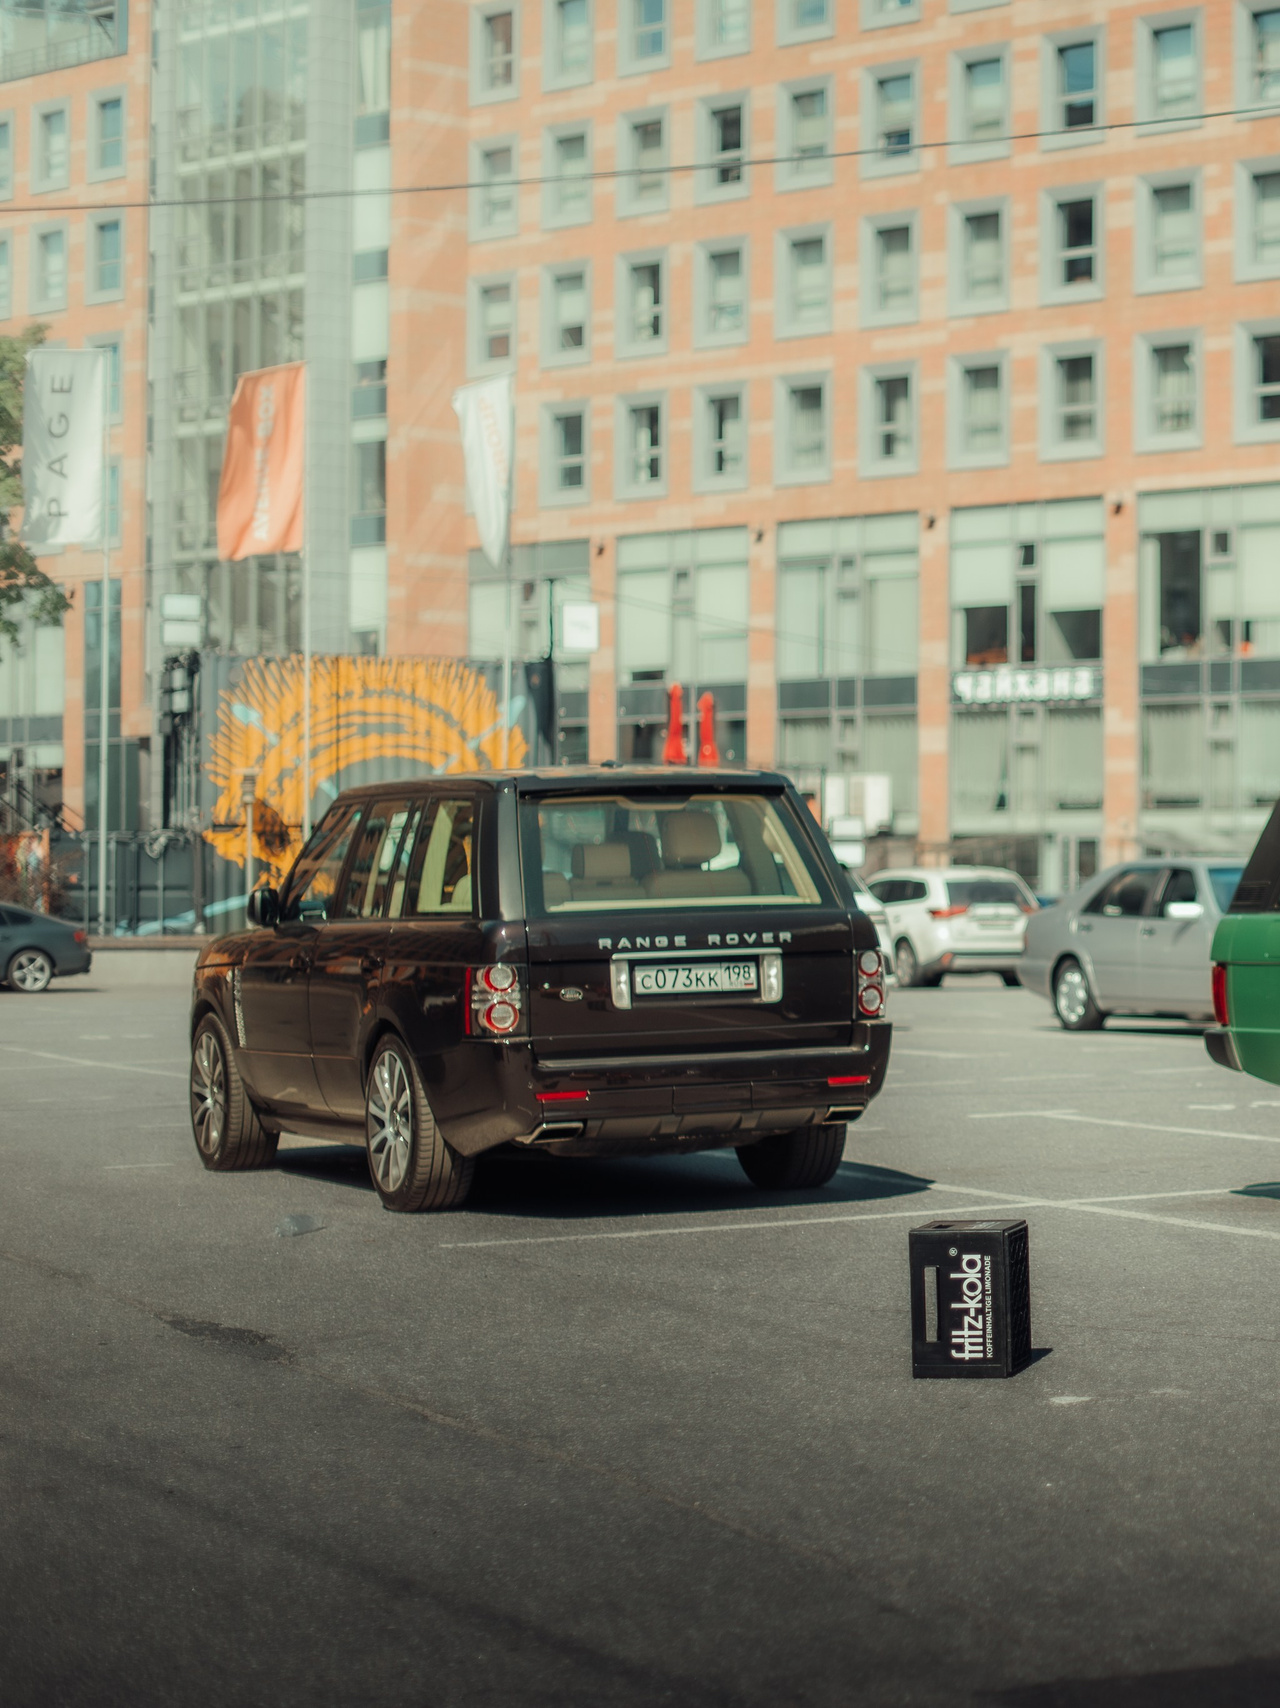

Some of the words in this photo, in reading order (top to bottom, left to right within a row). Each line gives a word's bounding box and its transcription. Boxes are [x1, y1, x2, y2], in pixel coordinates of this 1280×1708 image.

[46, 374, 74, 518] PAGE
[598, 935, 687, 950] RANGE
[707, 931, 792, 946] ROVER
[724, 964, 751, 980] 198
[984, 1255, 992, 1294] LIMONADE
[950, 1254, 984, 1361] fritz-kola
[985, 1295, 994, 1358] KOFFEINHALTIGE
